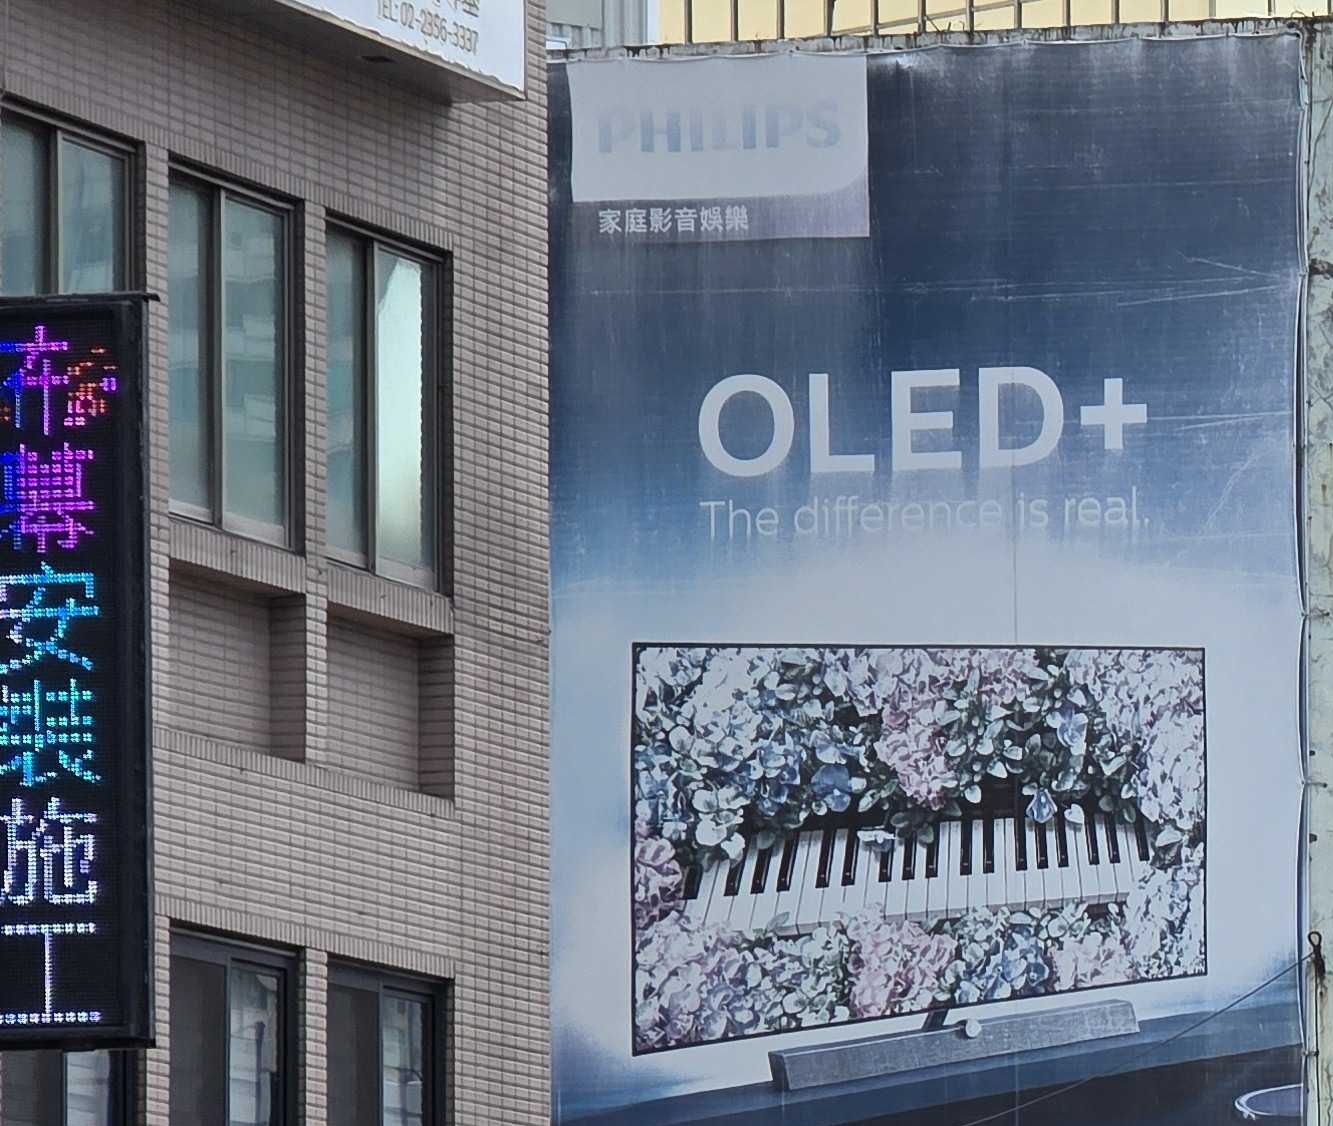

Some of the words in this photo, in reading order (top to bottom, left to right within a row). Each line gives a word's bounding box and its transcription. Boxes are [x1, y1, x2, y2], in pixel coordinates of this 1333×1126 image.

[598, 206, 749, 234] 家庭影音娛樂
[699, 366, 1148, 477] OLED+
[699, 501, 778, 541] The
[794, 496, 1000, 537] difference
[1017, 491, 1048, 530] is
[1064, 486, 1150, 530] real.
